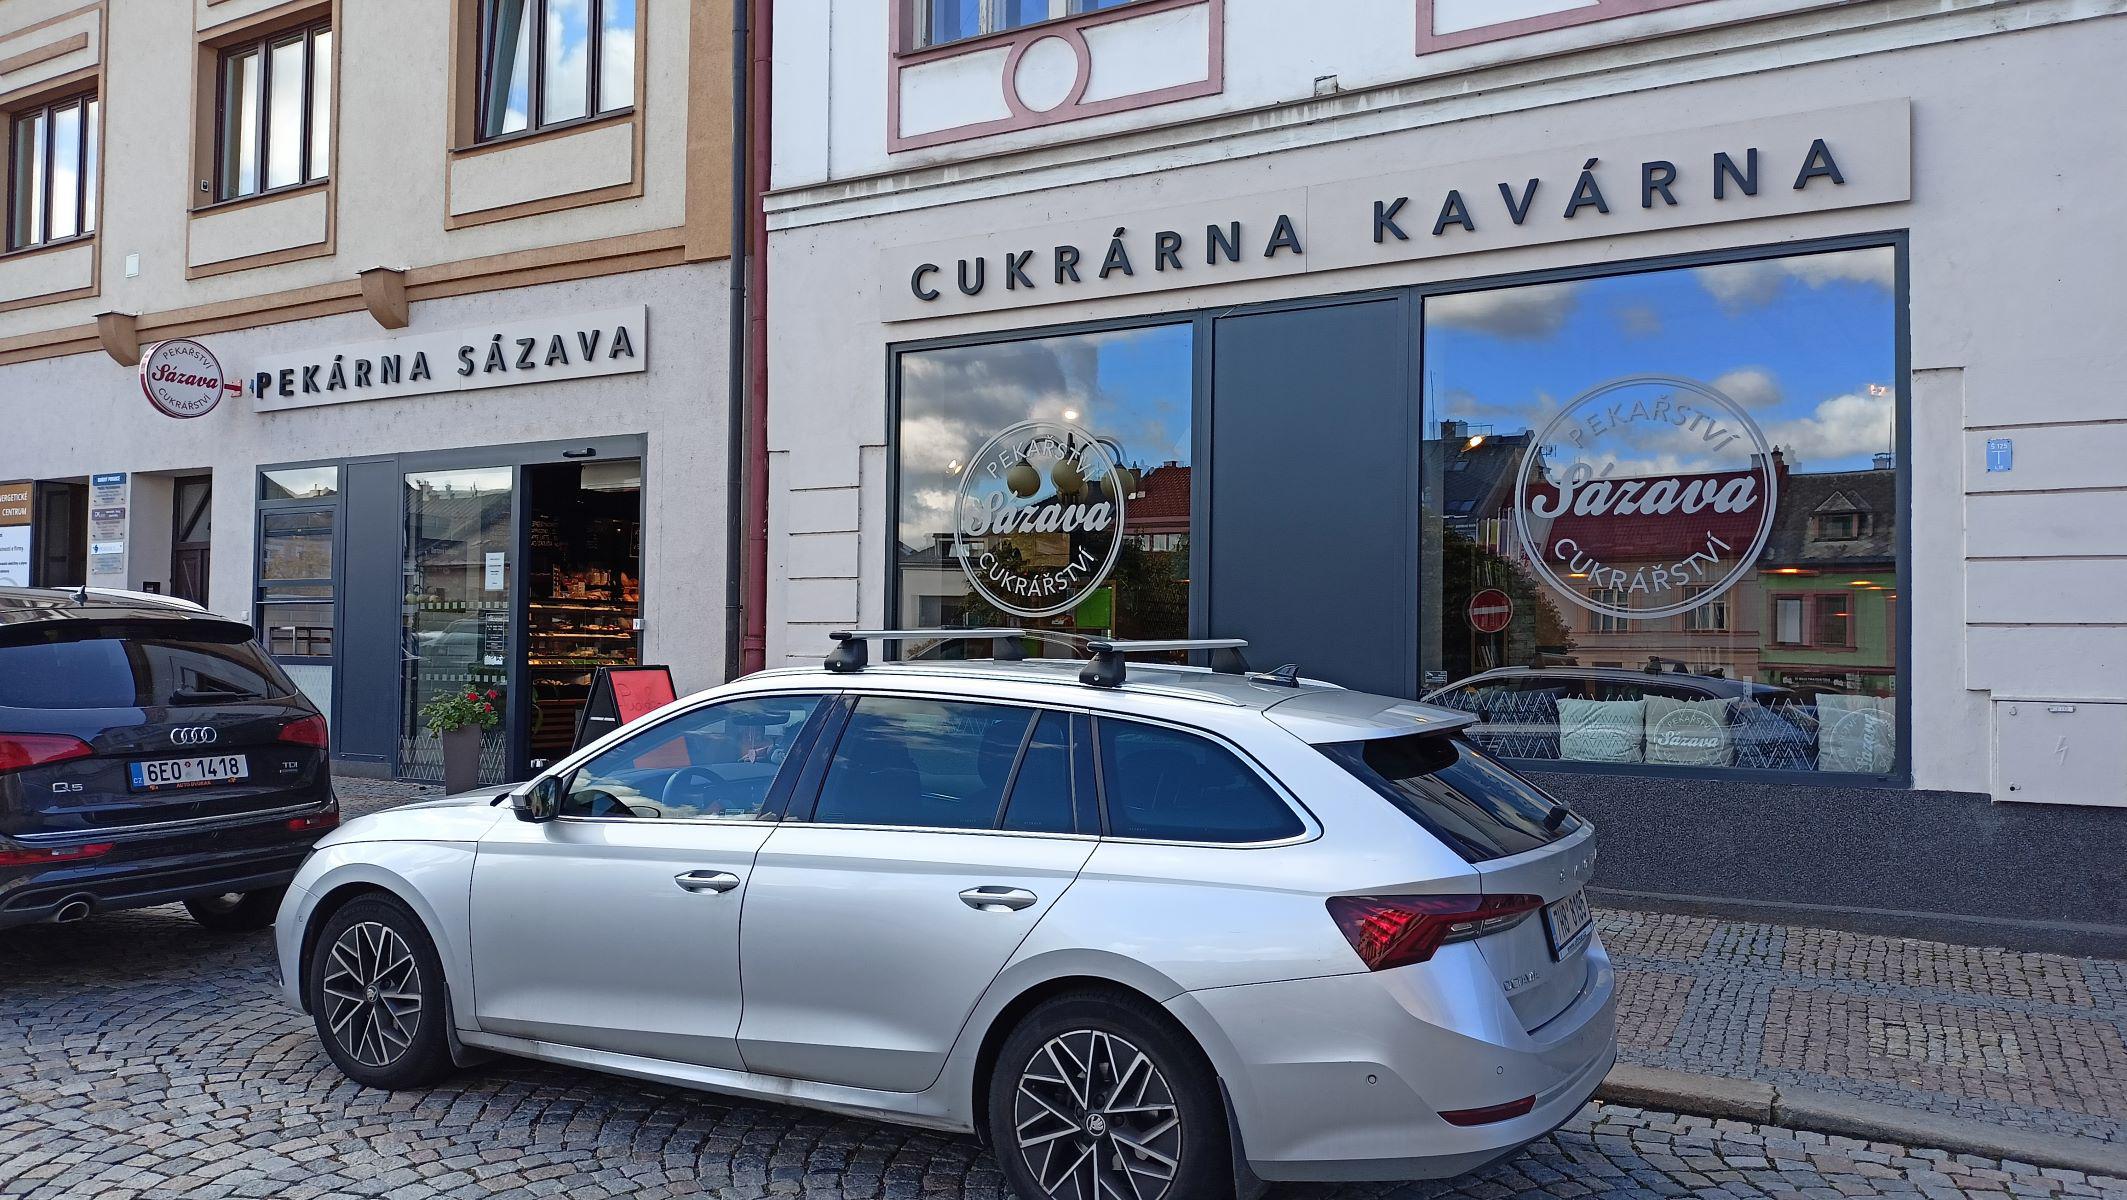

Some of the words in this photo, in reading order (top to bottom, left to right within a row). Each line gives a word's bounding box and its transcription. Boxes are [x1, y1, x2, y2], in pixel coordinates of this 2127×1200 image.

[910, 214, 1302, 301] CUKRÁRNA
[1373, 138, 1846, 244] KAVÁRNA
[152, 364, 218, 389] Sázava
[163, 347, 214, 369] PEKAŘSTVÍ
[255, 351, 432, 399] PEKÁRNA
[457, 326, 635, 376] SÁZAVA
[158, 388, 211, 410] CUKRÁŘSTVÍ
[1568, 394, 1741, 452] PEKAŘSTVÍ
[986, 434, 1097, 482] PEKAŘSTVÍ
[2, 507, 27, 516] CENTRUM
[963, 489, 1113, 537] Sázava
[1531, 462, 1758, 519] Sázava
[978, 544, 1096, 597] CUKRÁŘSTVÍ
[1554, 530, 1732, 595] CUKRÁŘSTVÍ
[1658, 730, 1719, 748] Sázava
[52, 782, 83, 793] Q5
[197, 757, 240, 778] 1418
